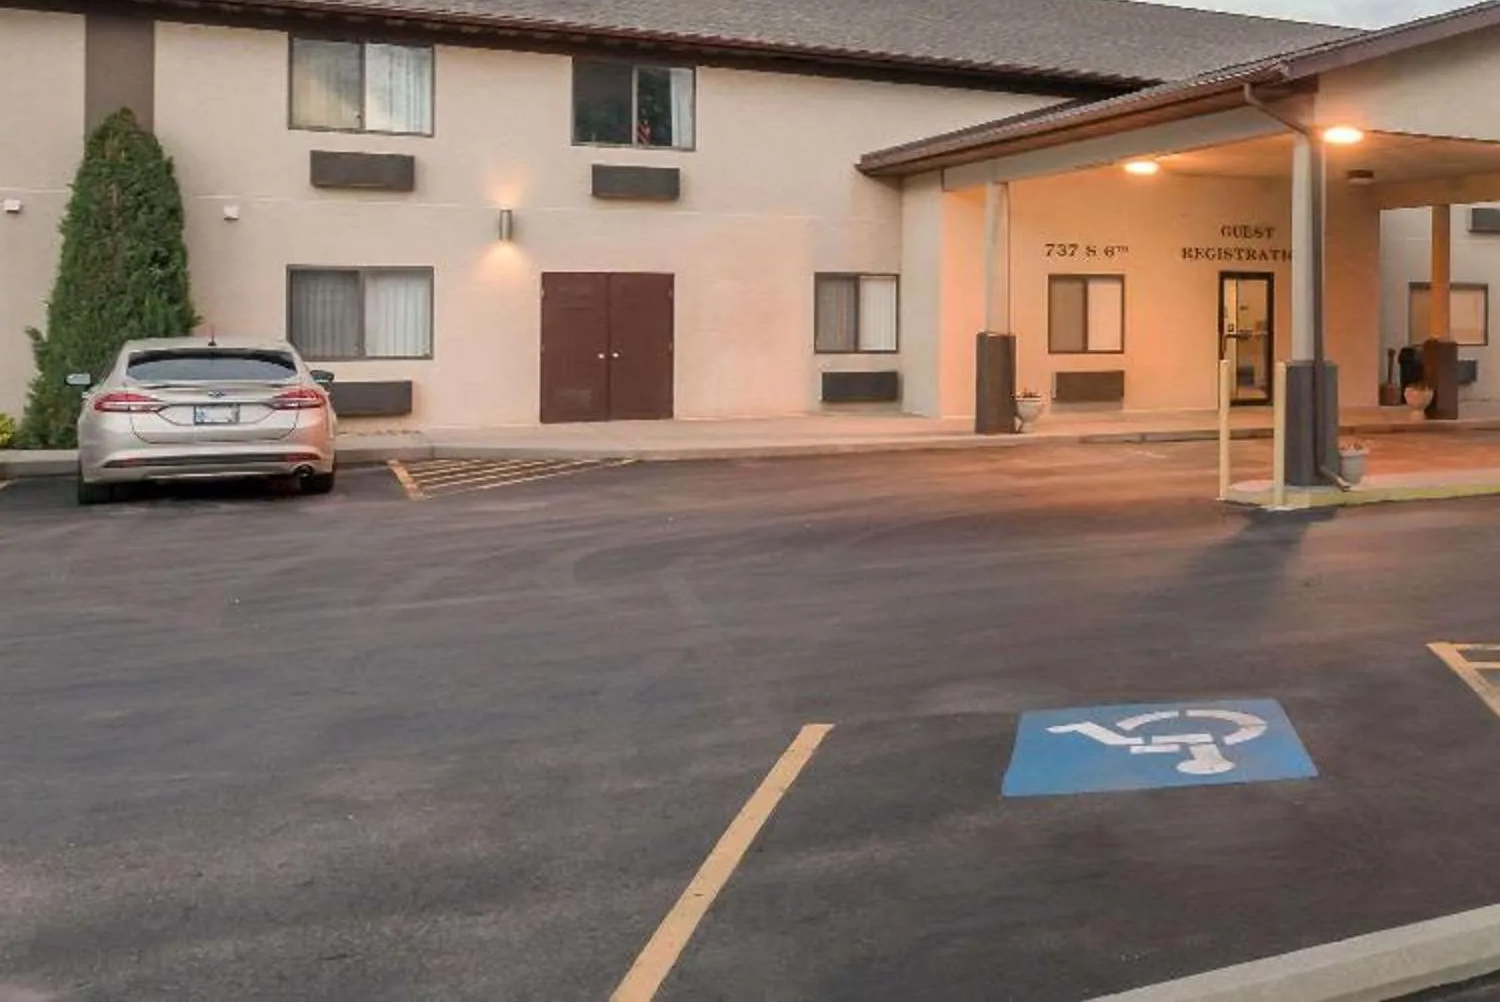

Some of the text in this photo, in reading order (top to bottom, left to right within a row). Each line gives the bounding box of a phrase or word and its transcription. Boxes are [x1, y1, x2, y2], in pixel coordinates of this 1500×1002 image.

[1219, 224, 1276, 239] GUEST
[1044, 243, 1079, 257] 737
[1085, 245, 1097, 257] S
[1181, 246, 1293, 261] REGISTRATI
